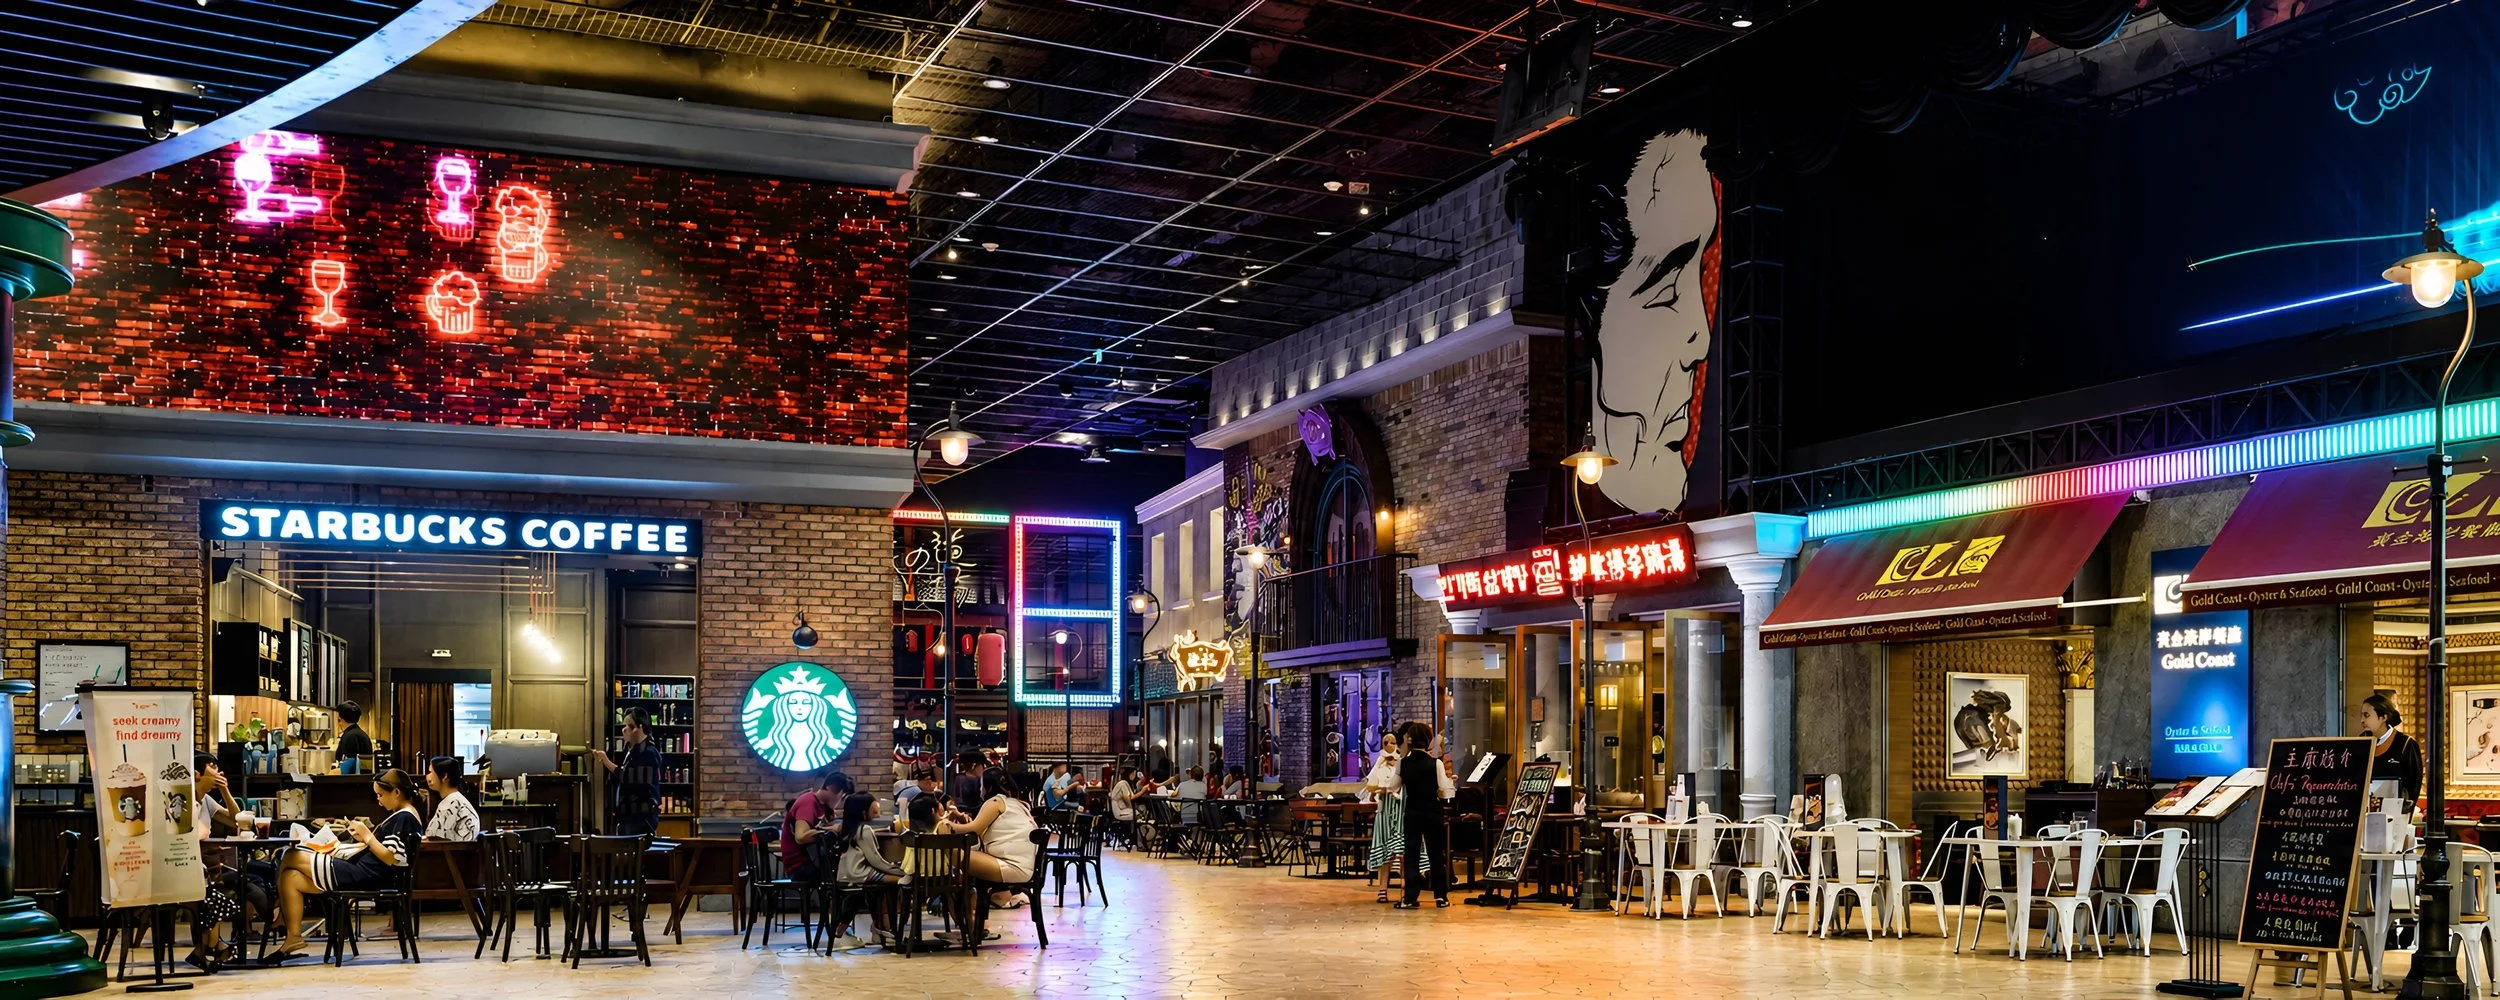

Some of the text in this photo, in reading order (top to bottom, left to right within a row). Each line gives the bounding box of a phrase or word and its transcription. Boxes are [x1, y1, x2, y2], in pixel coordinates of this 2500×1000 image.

[221, 507, 688, 553] STARBUCKS COFFEE
[2191, 594, 2214, 607] Gold
[2216, 593, 2243, 604] Coast
[2249, 591, 2279, 605] Oyster
[2289, 585, 2327, 598] Seafood
[2335, 581, 2362, 595] Gold
[2364, 580, 2396, 593] Coast
[2449, 571, 2490, 587] Seafood
[2161, 652, 2236, 669] Gold Coast
[113, 716, 181, 727] seek creamy
[116, 731, 182, 741] find dreamy
